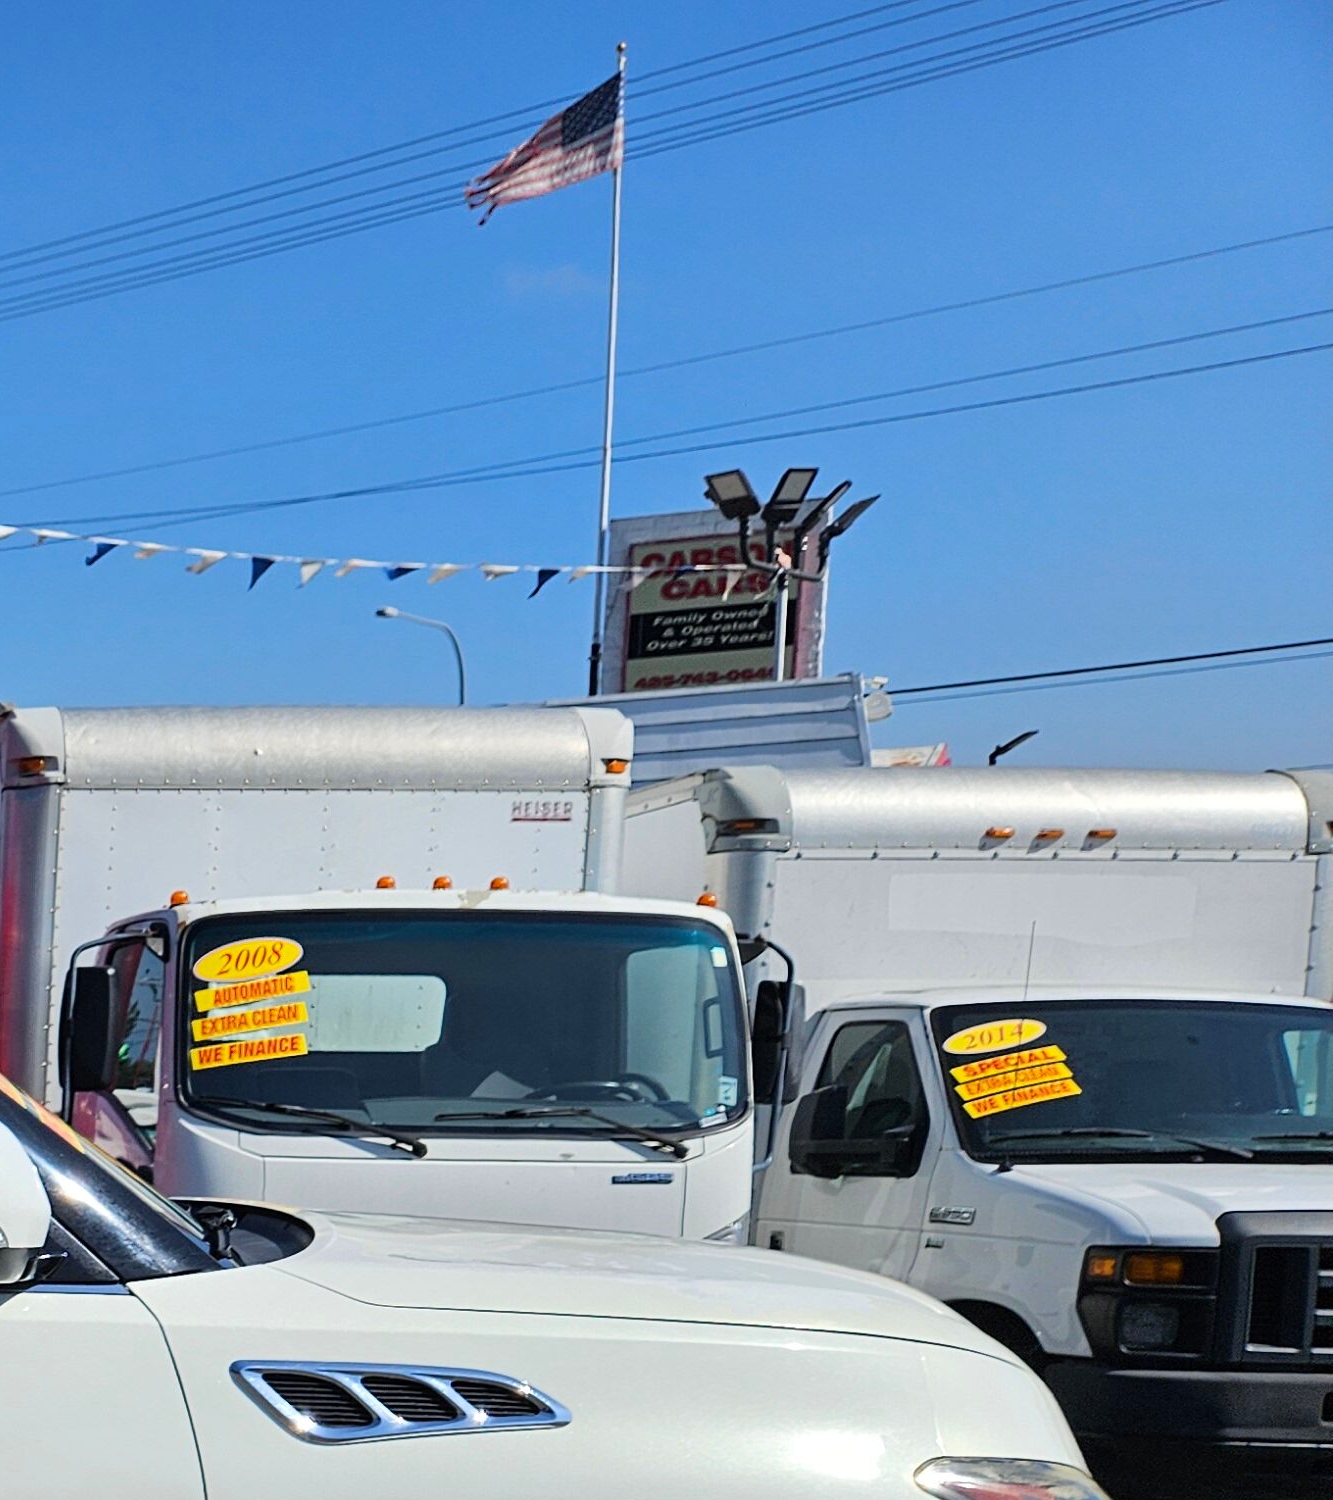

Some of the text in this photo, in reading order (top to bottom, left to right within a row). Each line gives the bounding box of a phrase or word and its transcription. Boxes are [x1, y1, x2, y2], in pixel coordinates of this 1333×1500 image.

[652, 604, 769, 627] Family Owned
[680, 619, 759, 636] Operated
[645, 640, 687, 652] Over
[217, 942, 283, 975] 2008
[213, 976, 294, 1006] AUTOMATIC
[200, 1006, 299, 1036] EXTRA CLEAN
[198, 1035, 299, 1065] WE FINANCE
[964, 1023, 1023, 1050] 2014
[973, 1099, 998, 1113] WE
